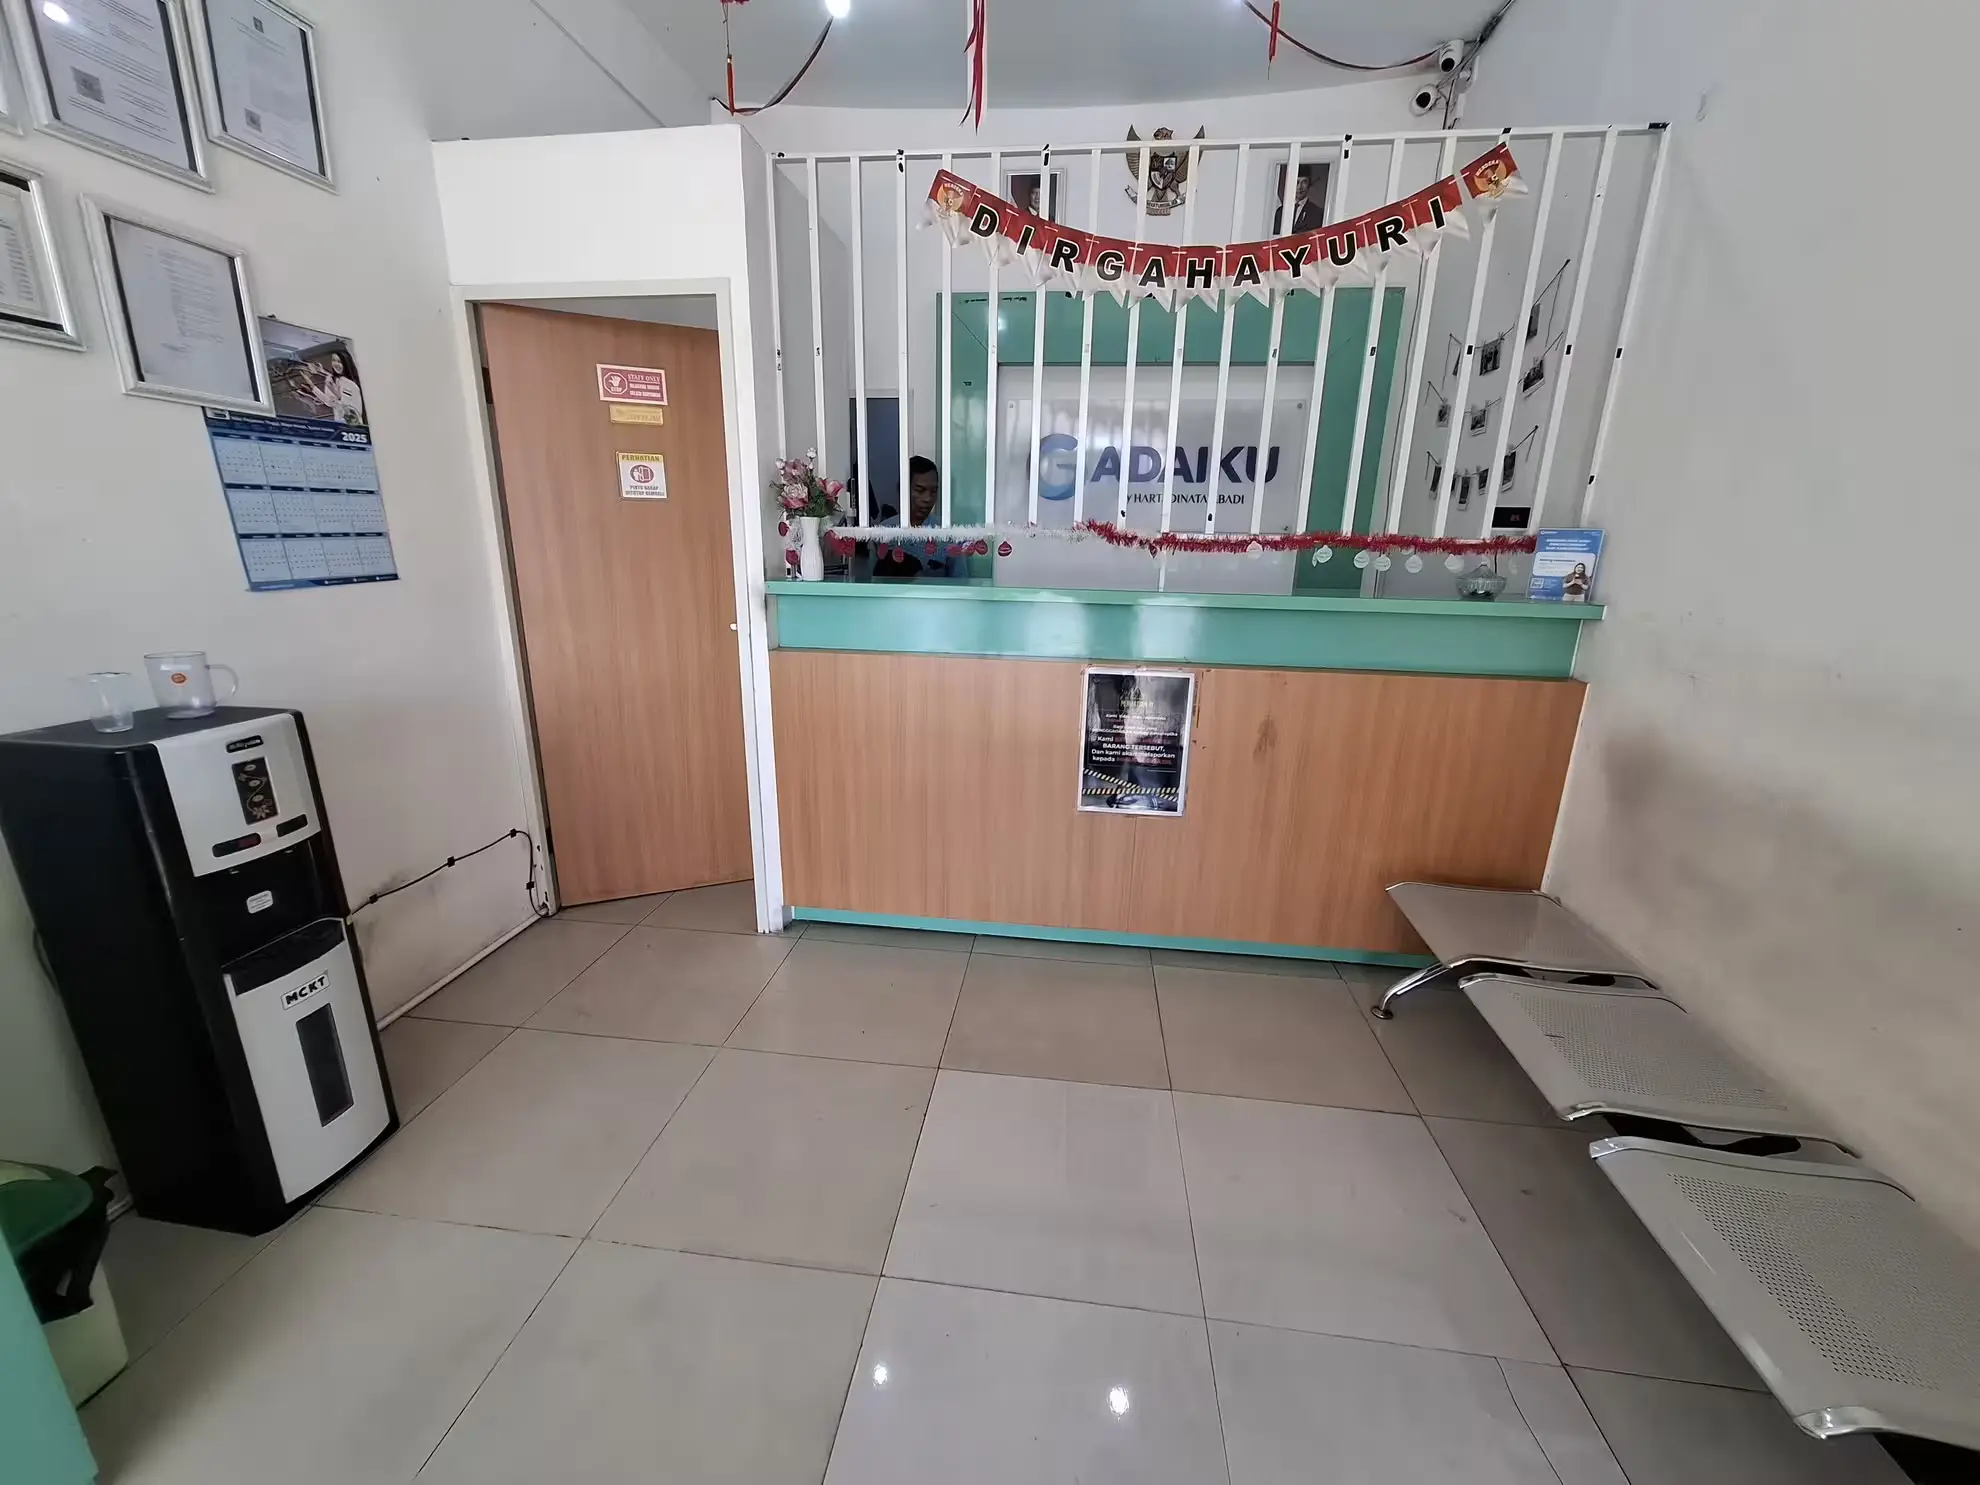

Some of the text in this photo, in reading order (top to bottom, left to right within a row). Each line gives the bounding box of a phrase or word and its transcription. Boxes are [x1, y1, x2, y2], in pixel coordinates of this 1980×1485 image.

[341, 432, 368, 443] 2025
[1216, 494, 1245, 505] BADI
[285, 975, 325, 1005] MCKT
